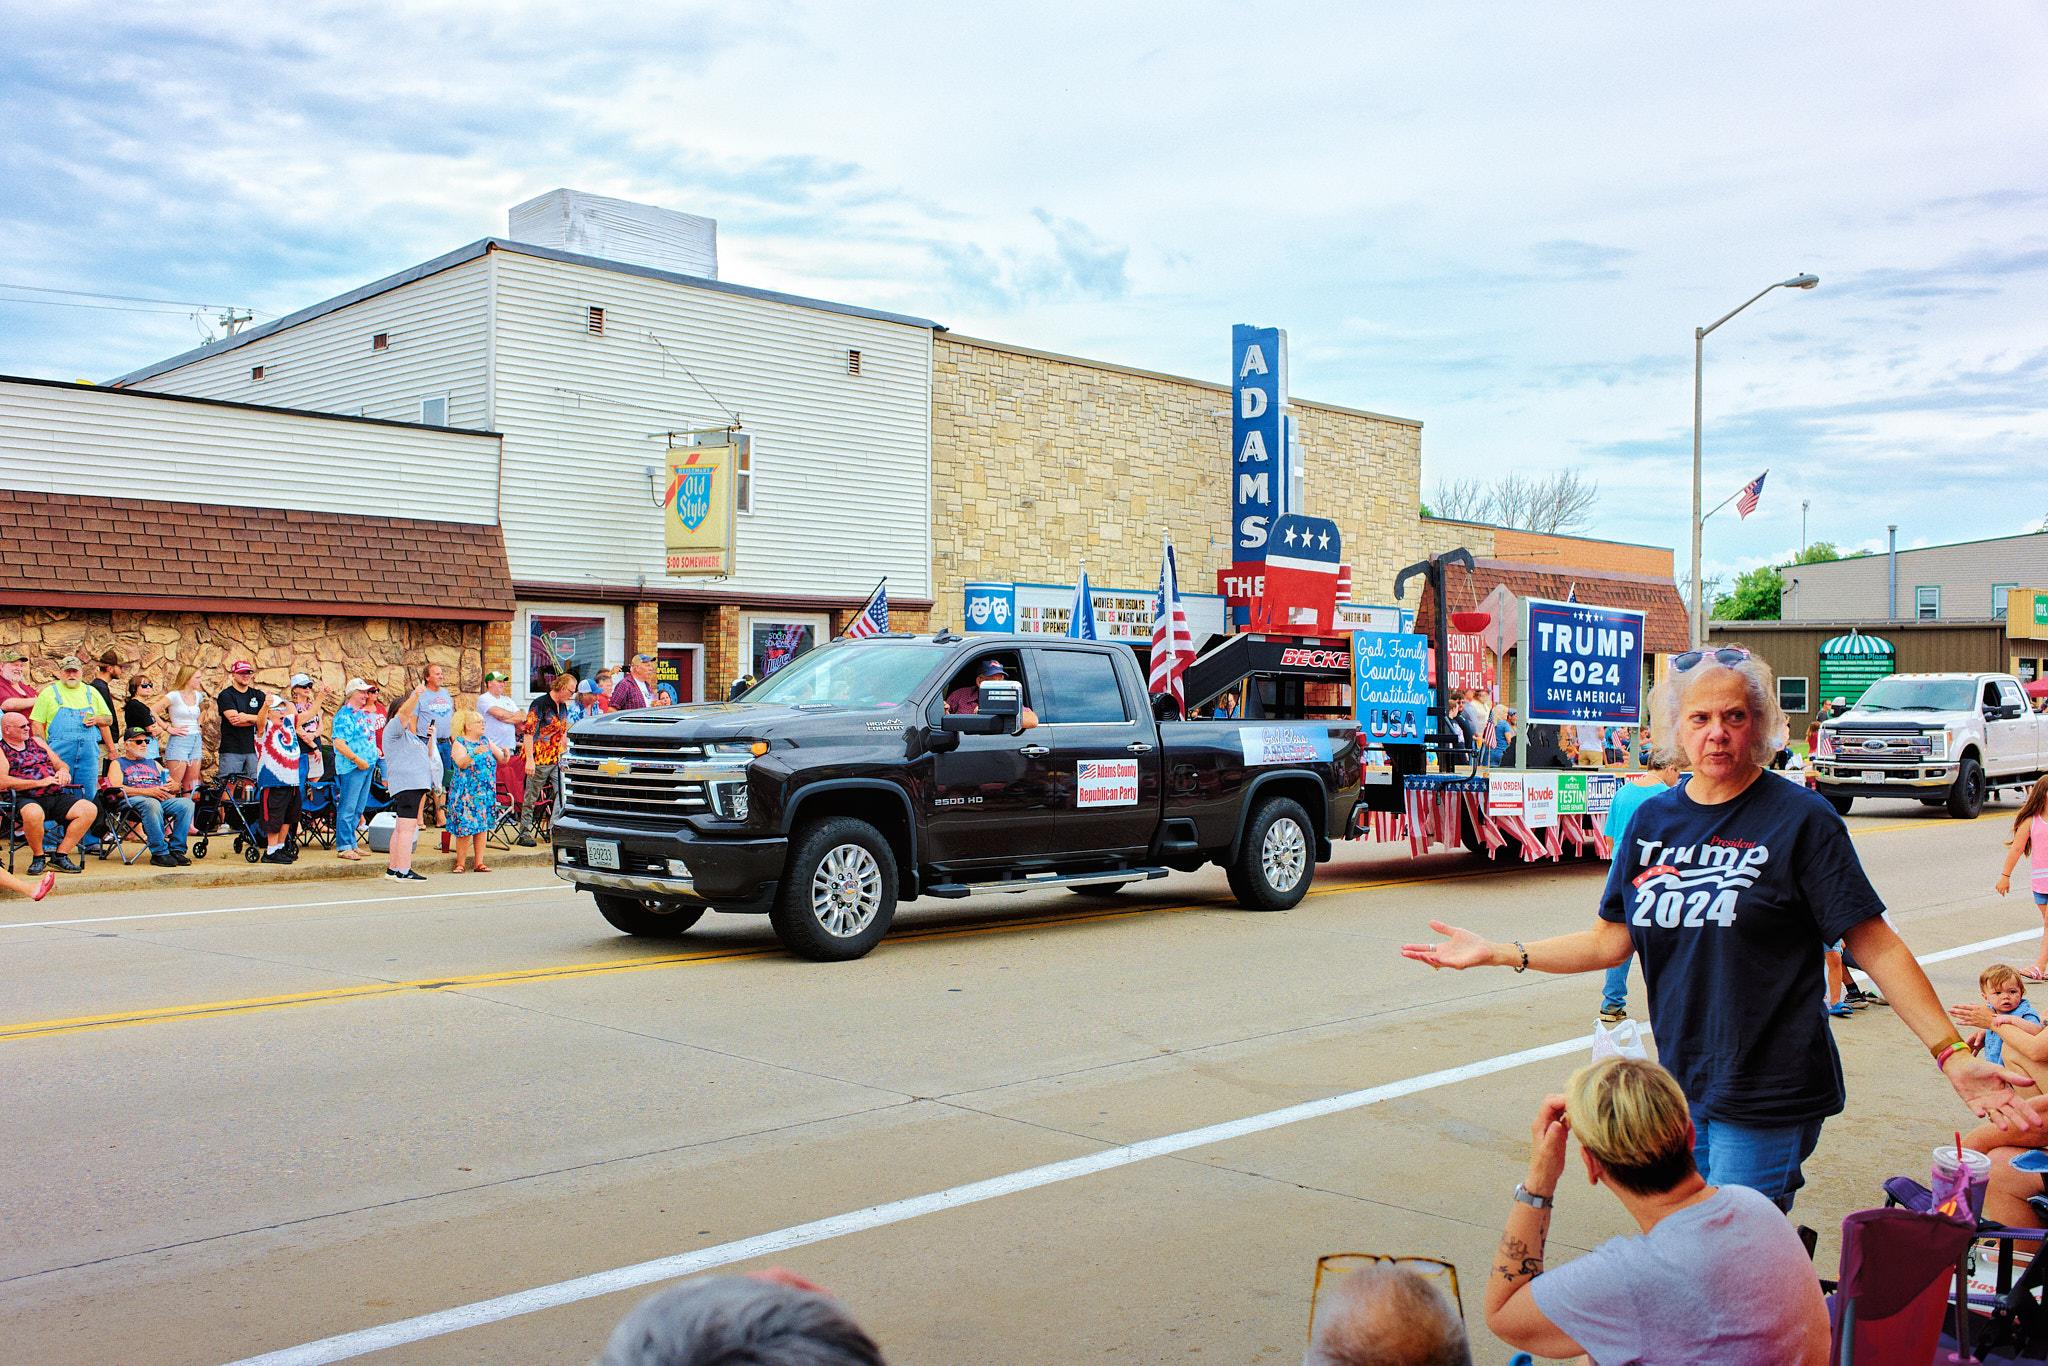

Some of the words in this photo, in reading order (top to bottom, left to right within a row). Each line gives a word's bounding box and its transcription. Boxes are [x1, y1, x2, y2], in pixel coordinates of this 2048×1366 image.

[1239, 344, 1270, 549] ADAMS
[685, 475, 705, 497] Old
[679, 495, 708, 526] Style
[666, 557, 680, 569] 5:00
[681, 556, 720, 569] SOMEWHERE
[1223, 575, 1266, 598] THE
[1093, 598, 1113, 609] MOVIES
[1115, 598, 1145, 610] THURSDAYS
[1020, 607, 1032, 619] JUL
[1041, 608, 1057, 620] JOHN
[1096, 611, 1107, 622] JUL
[1117, 612, 1134, 623] MAGIC
[1135, 613, 1148, 624] MIKE
[1020, 621, 1032, 633] JUL
[1357, 636, 1388, 659] God,
[1388, 639, 1427, 661] Family
[1447, 633, 1480, 653] ECURITY
[1537, 621, 1635, 659] TRUMP
[1280, 648, 1350, 669] BECKE
[1450, 653, 1474, 671] TRUTH
[1360, 655, 1416, 689] Country
[1419, 663, 1427, 683] &
[1552, 659, 1620, 686] 2024
[1360, 681, 1427, 705] Constitution
[1547, 688, 1573, 701] SAVE
[1575, 690, 1626, 705] AMERICA!
[1370, 708, 1418, 739] USA
[1263, 745, 1319, 762] AMERICA
[1097, 764, 1116, 778] Adams
[1117, 764, 1136, 778] County
[1080, 787, 1118, 803] Republican
[1119, 786, 1136, 801] Party
[1491, 781, 1503, 791] VAN
[1503, 781, 1522, 791] ORDEN
[1527, 787, 1553, 801] Hovde
[935, 798, 964, 806] 2500
[1559, 790, 1585, 804] TESTIN
[1709, 835, 1757, 849] President
[1637, 838, 1769, 870] Trump
[1632, 890, 1739, 928] 2024
